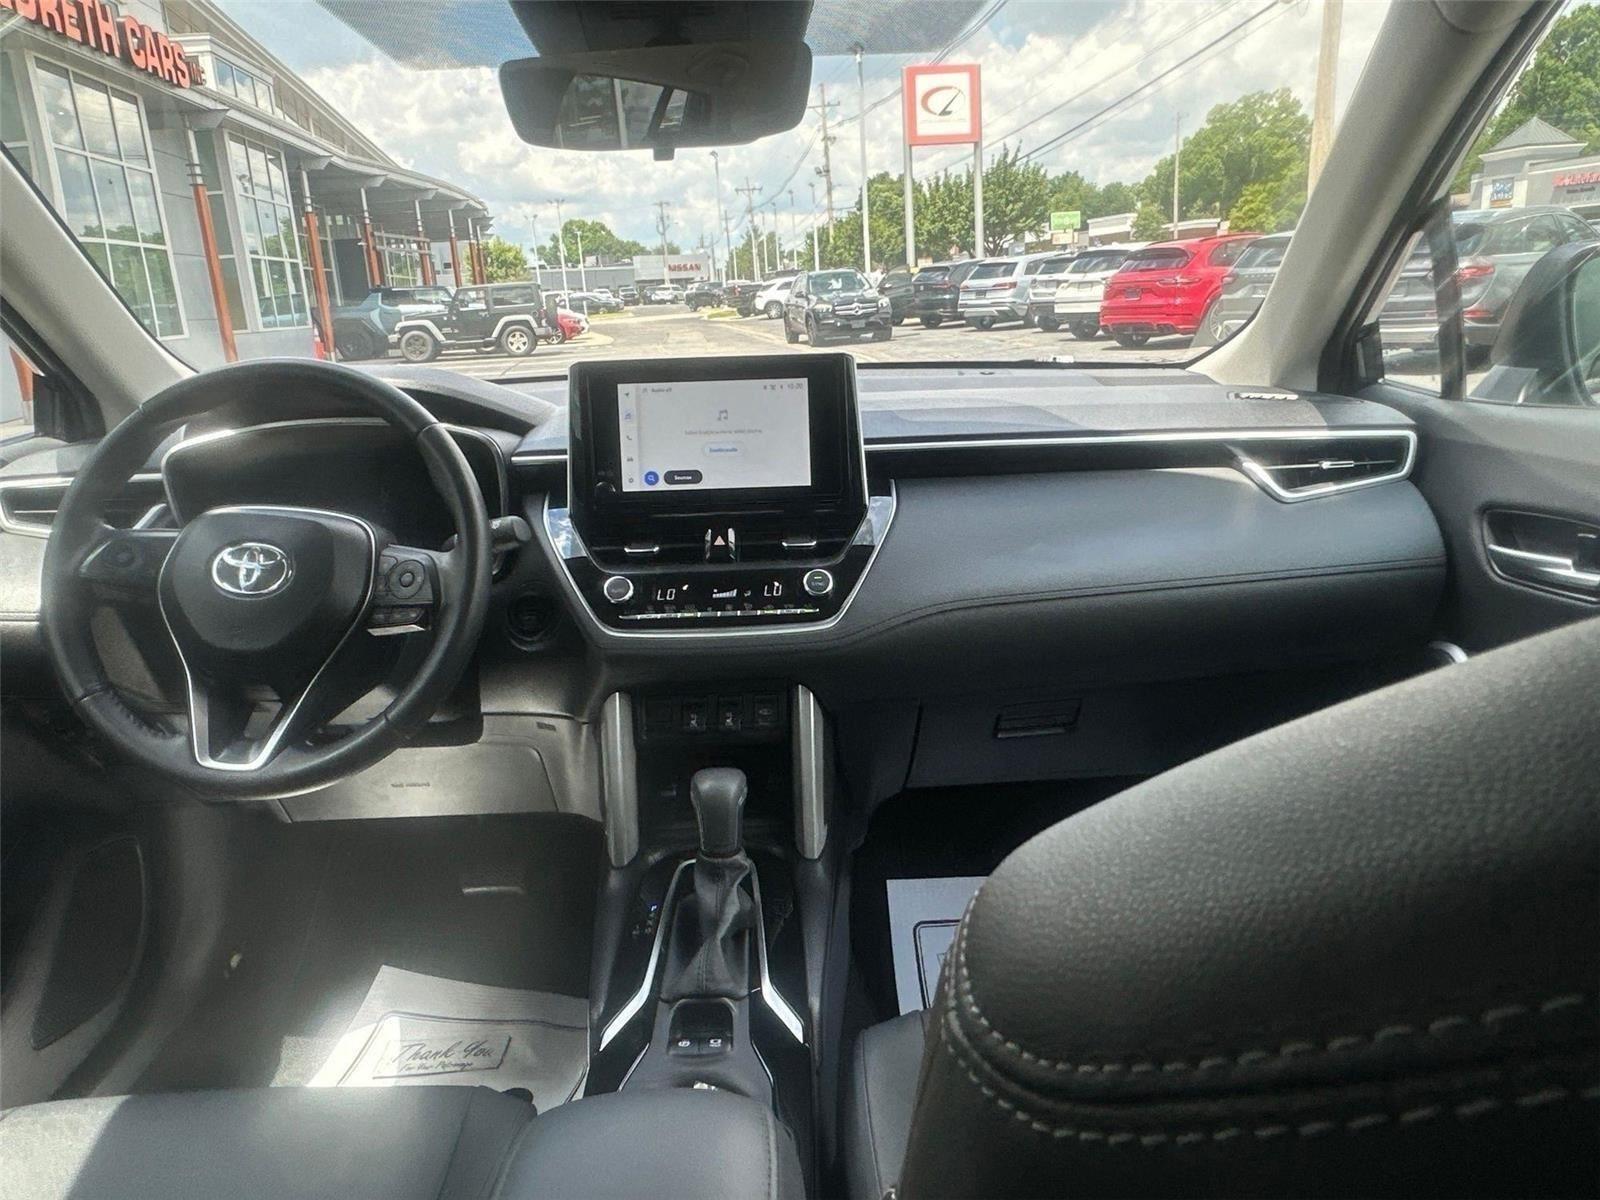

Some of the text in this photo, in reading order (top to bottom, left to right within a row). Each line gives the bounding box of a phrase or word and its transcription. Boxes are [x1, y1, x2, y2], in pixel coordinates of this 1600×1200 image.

[118, 15, 191, 89] CARS
[668, 263, 701, 272] NISSAN
[657, 588, 675, 600] LO
[392, 1040, 495, 1063] Thank You
